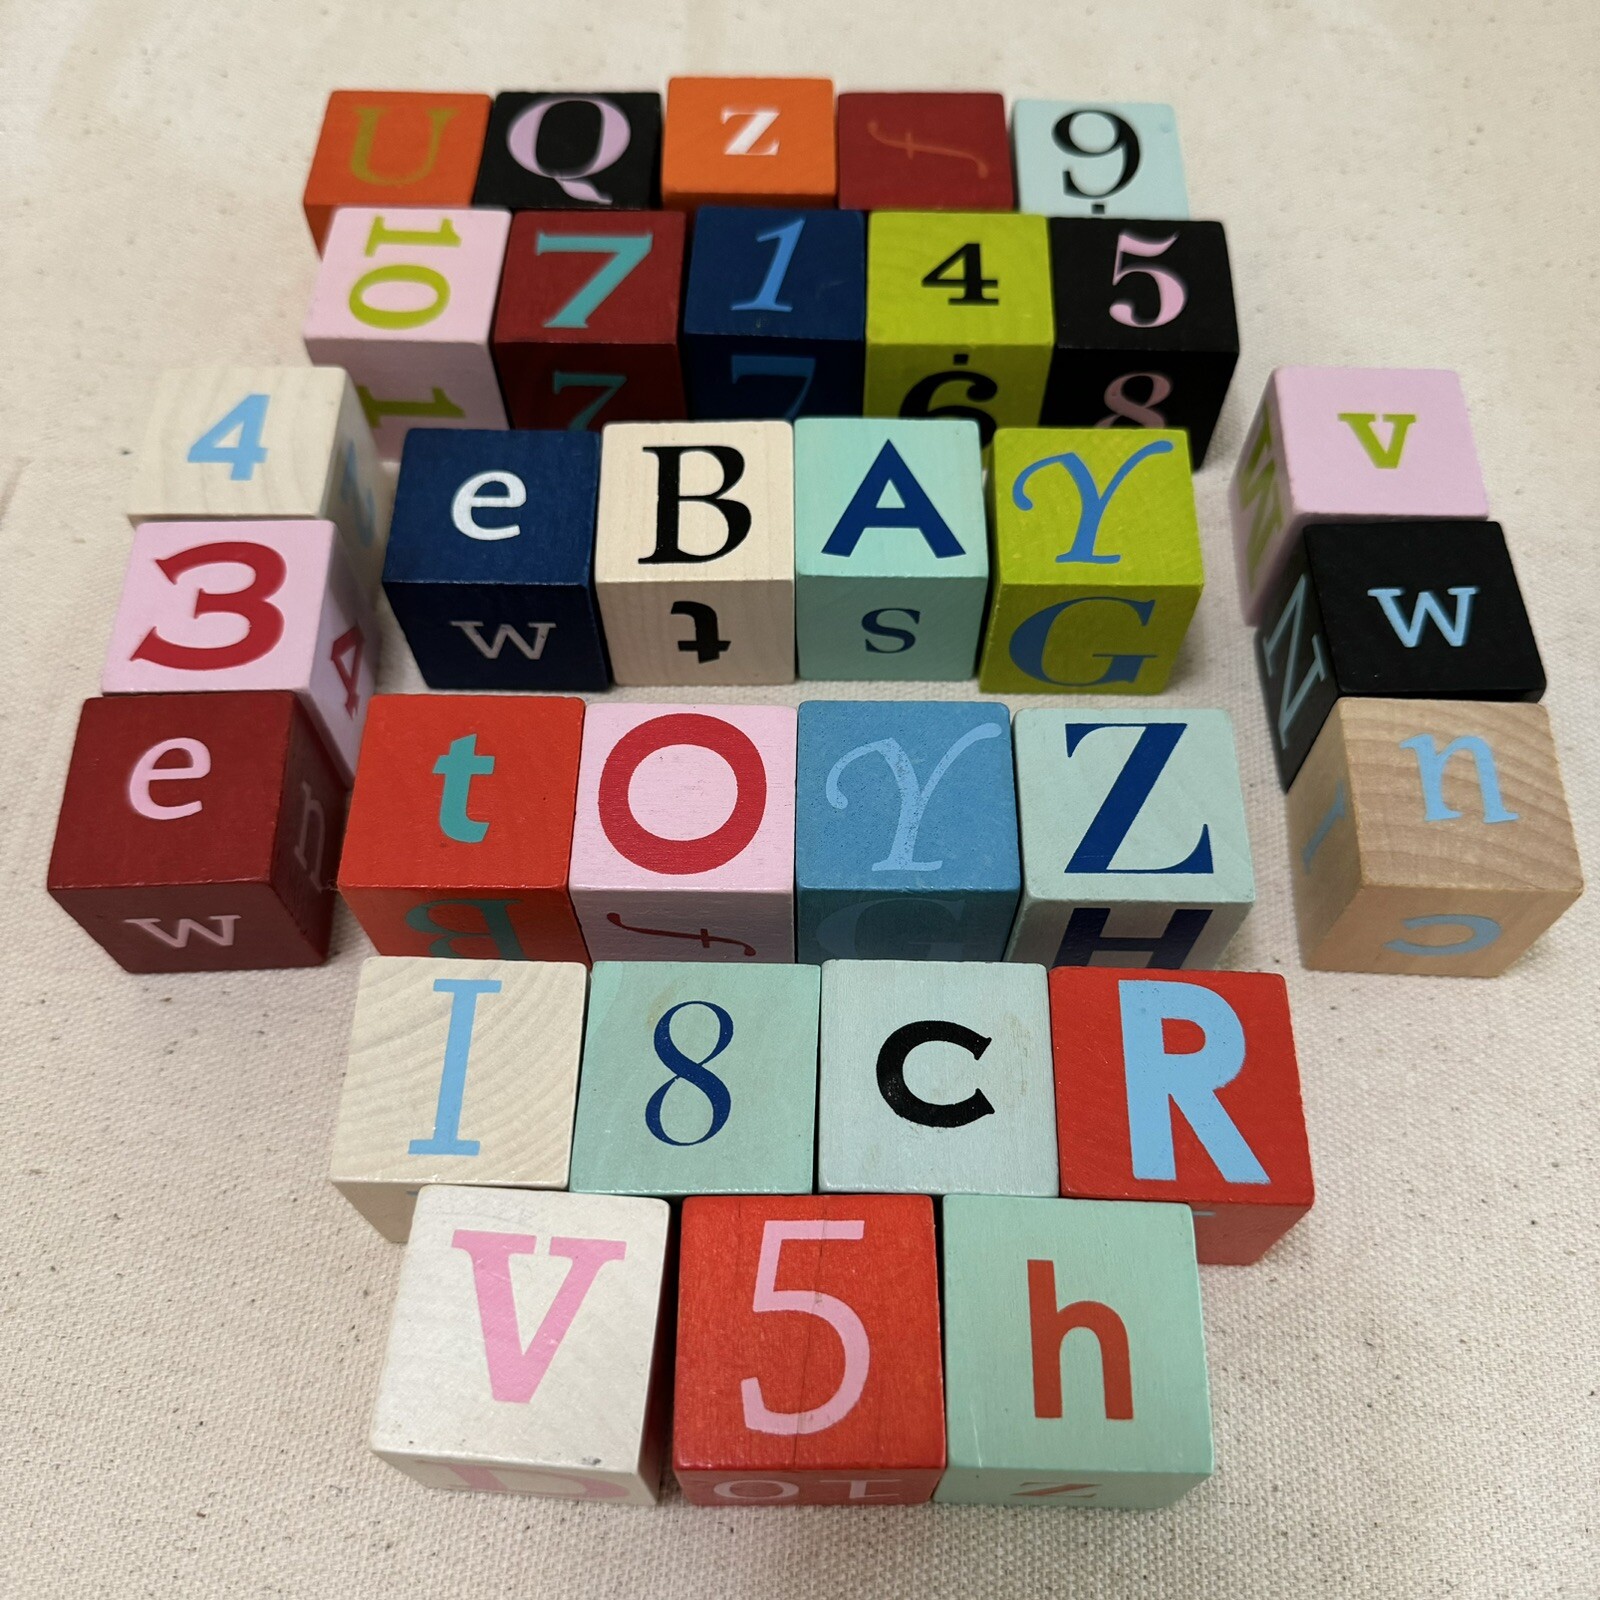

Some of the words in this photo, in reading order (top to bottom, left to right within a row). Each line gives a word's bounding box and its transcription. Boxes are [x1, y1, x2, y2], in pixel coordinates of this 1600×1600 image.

[348, 107, 459, 187] U
[507, 98, 631, 205] Q
[348, 215, 463, 330] 10
[535, 231, 653, 328] 7
[730, 216, 806, 313] 1
[920, 242, 1000, 306] 4
[1109, 230, 1188, 328] 5
[186, 393, 271, 482] 4
[451, 469, 527, 541] e
[638, 444, 752, 565] B
[821, 439, 966, 559] A
[1012, 440, 1173, 564] Y
[129, 541, 287, 671] 3
[671, 601, 731, 663] t
[1008, 596, 1157, 687] G
[128, 737, 211, 821] e
[432, 733, 495, 844] t
[598, 712, 767, 875] O
[825, 721, 1003, 872] Y
[1063, 722, 1214, 874] Z
[1401, 731, 1519, 824] n
[1052, 907, 1214, 970] H
[407, 978, 502, 1157] I
[645, 1000, 734, 1147] 8
[1118, 979, 1271, 1185] R
[451, 1229, 627, 1404] V
[740, 1219, 870, 1436] 5
[1027, 1259, 1134, 1420] h
